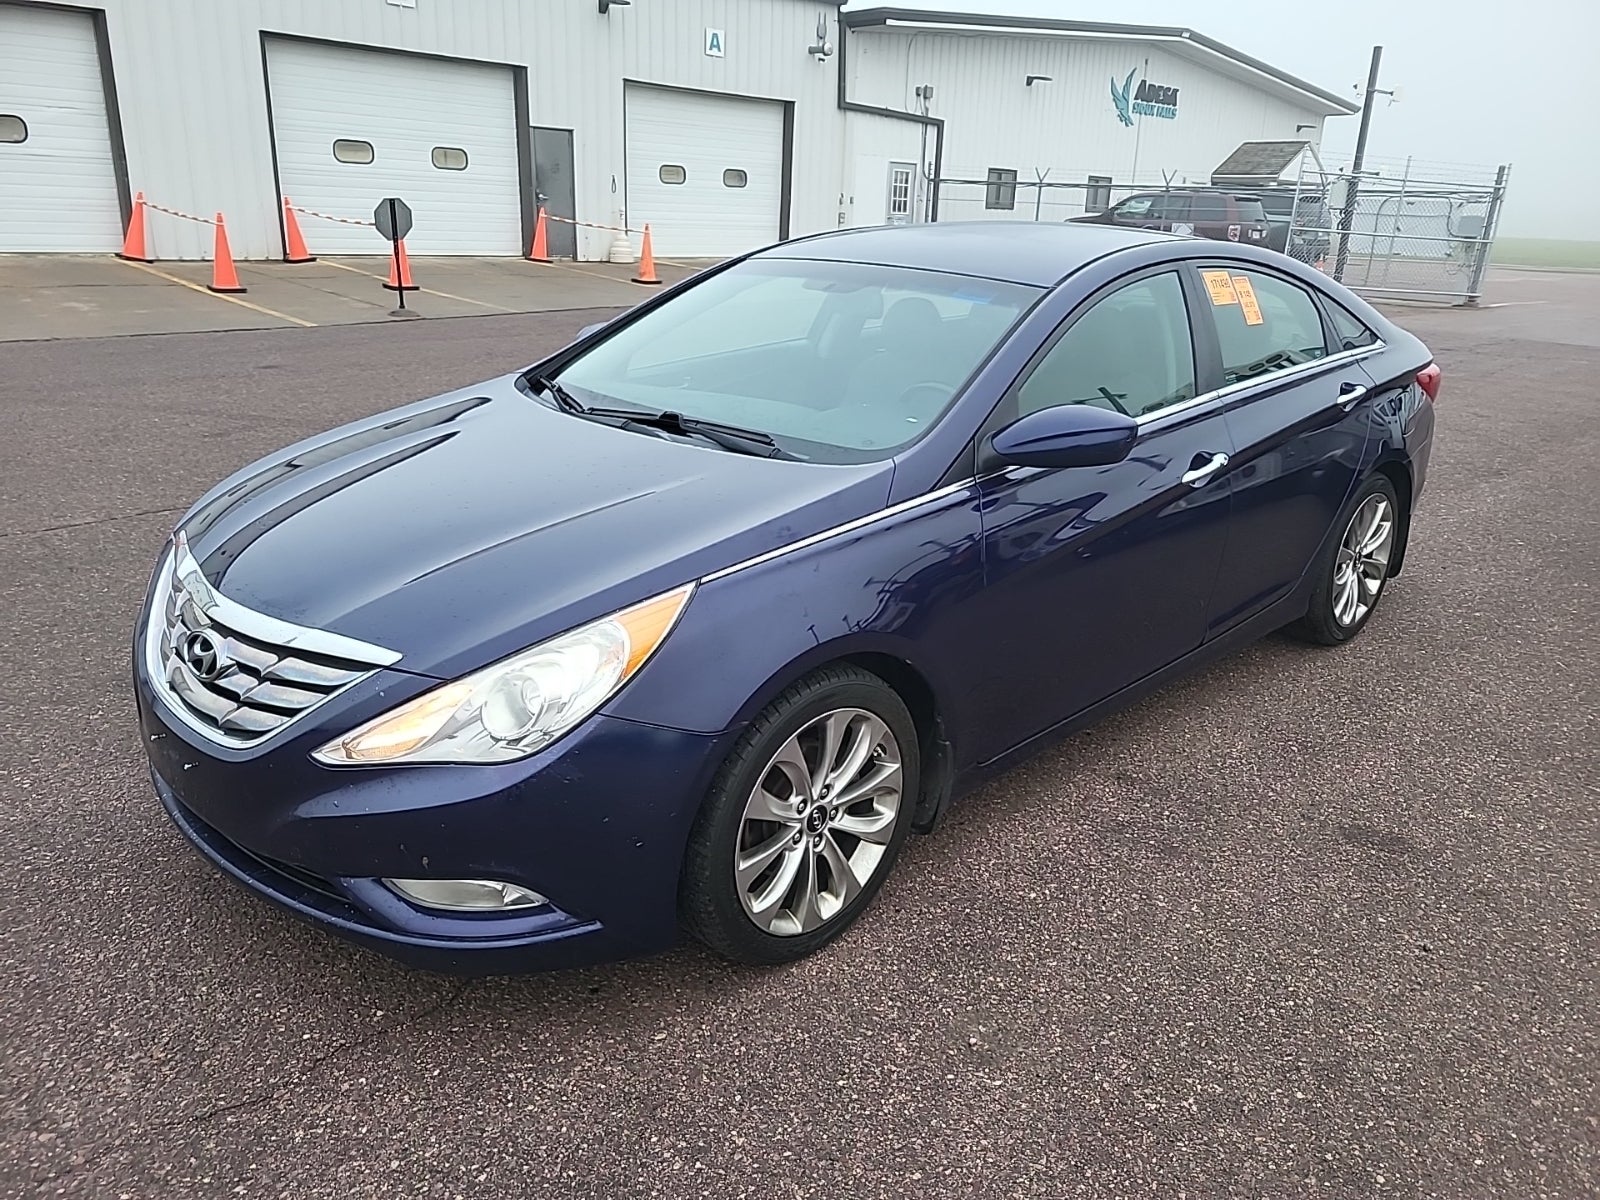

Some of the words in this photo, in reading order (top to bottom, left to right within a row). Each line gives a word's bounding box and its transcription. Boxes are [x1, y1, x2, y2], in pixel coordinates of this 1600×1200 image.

[708, 32, 722, 53] A
[1131, 101, 1157, 118] SIOUX
[1155, 105, 1178, 120] FALLS
